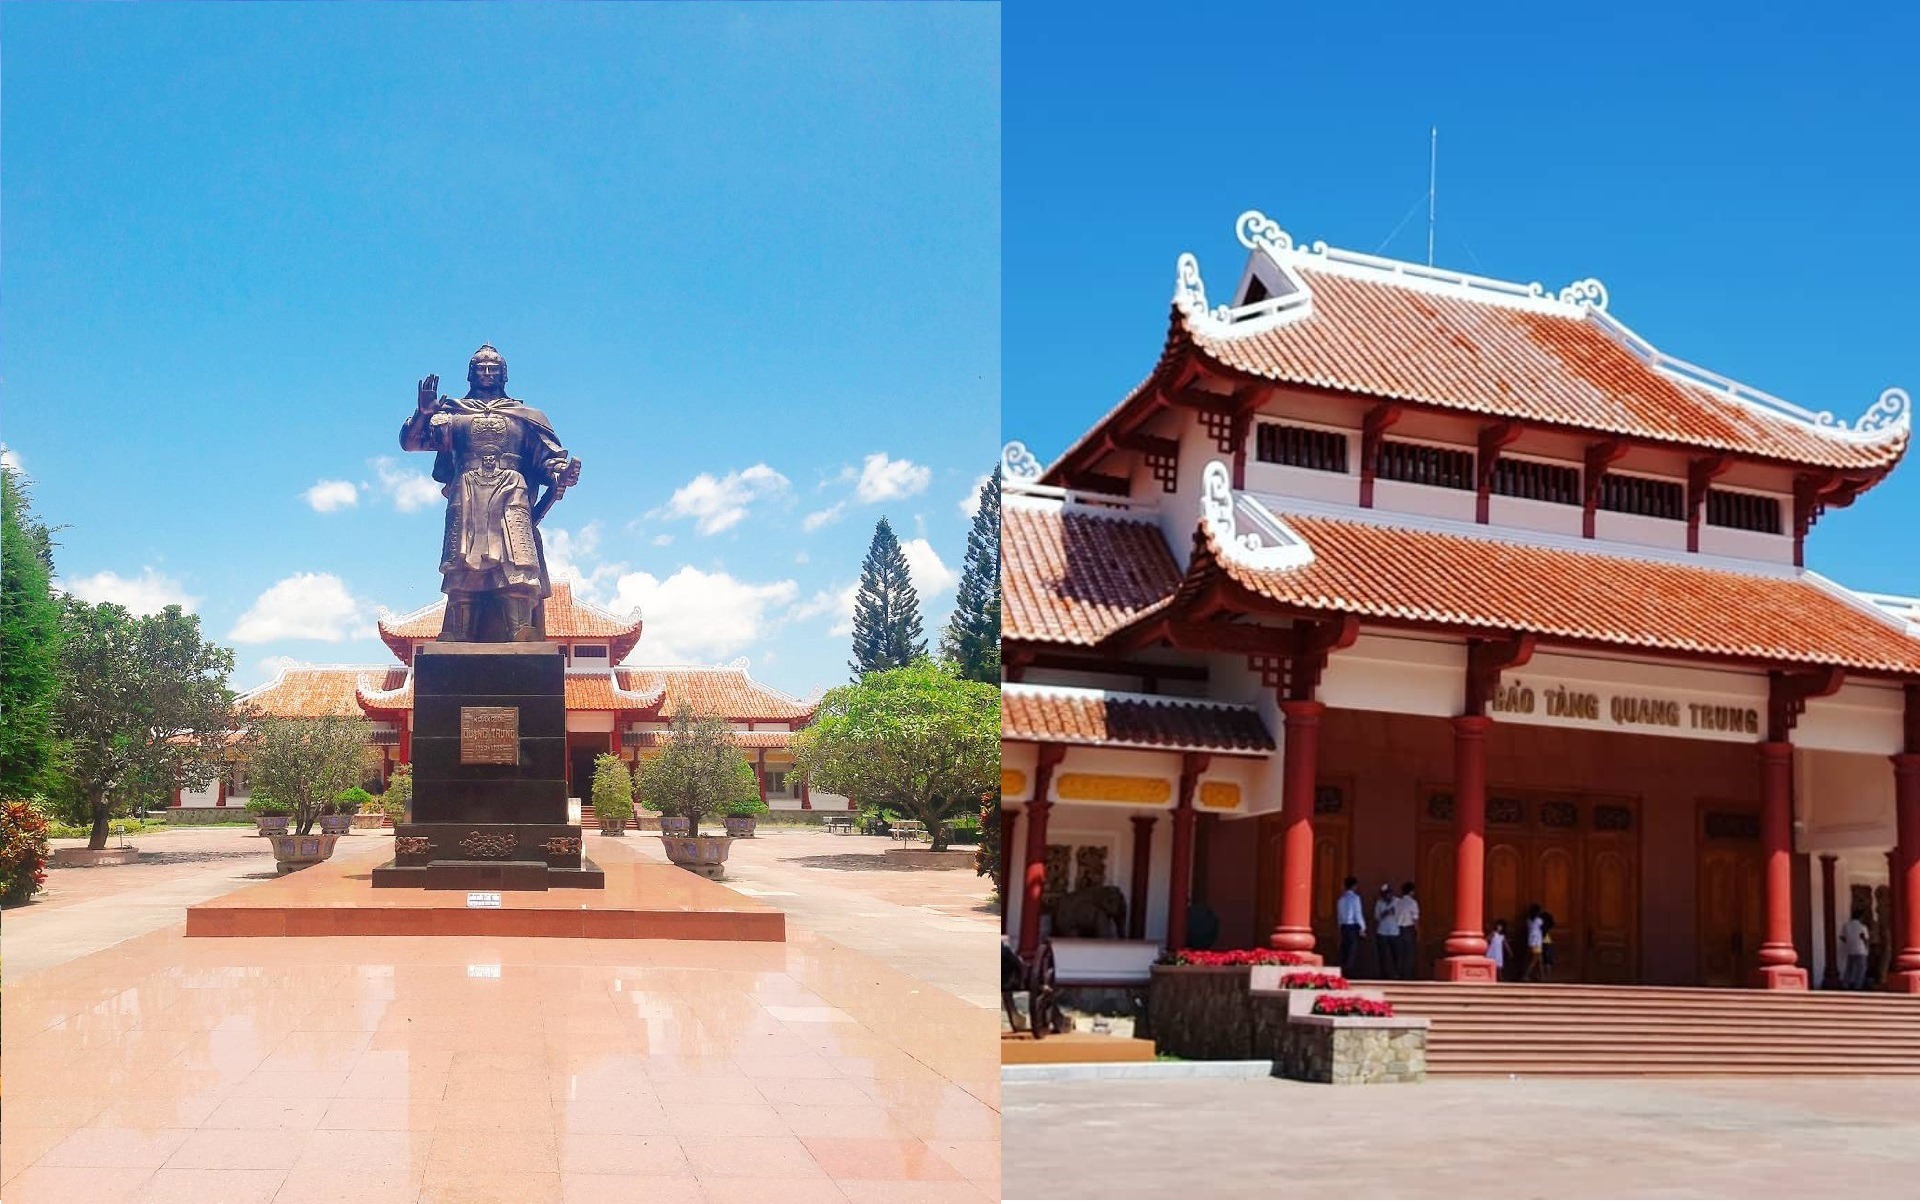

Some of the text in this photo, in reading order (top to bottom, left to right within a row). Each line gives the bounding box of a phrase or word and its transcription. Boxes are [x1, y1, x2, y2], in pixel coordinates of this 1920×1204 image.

[1544, 684, 1599, 720] TÀNG
[1610, 696, 1680, 726] QUANG
[1688, 703, 1758, 734] TRUNG
